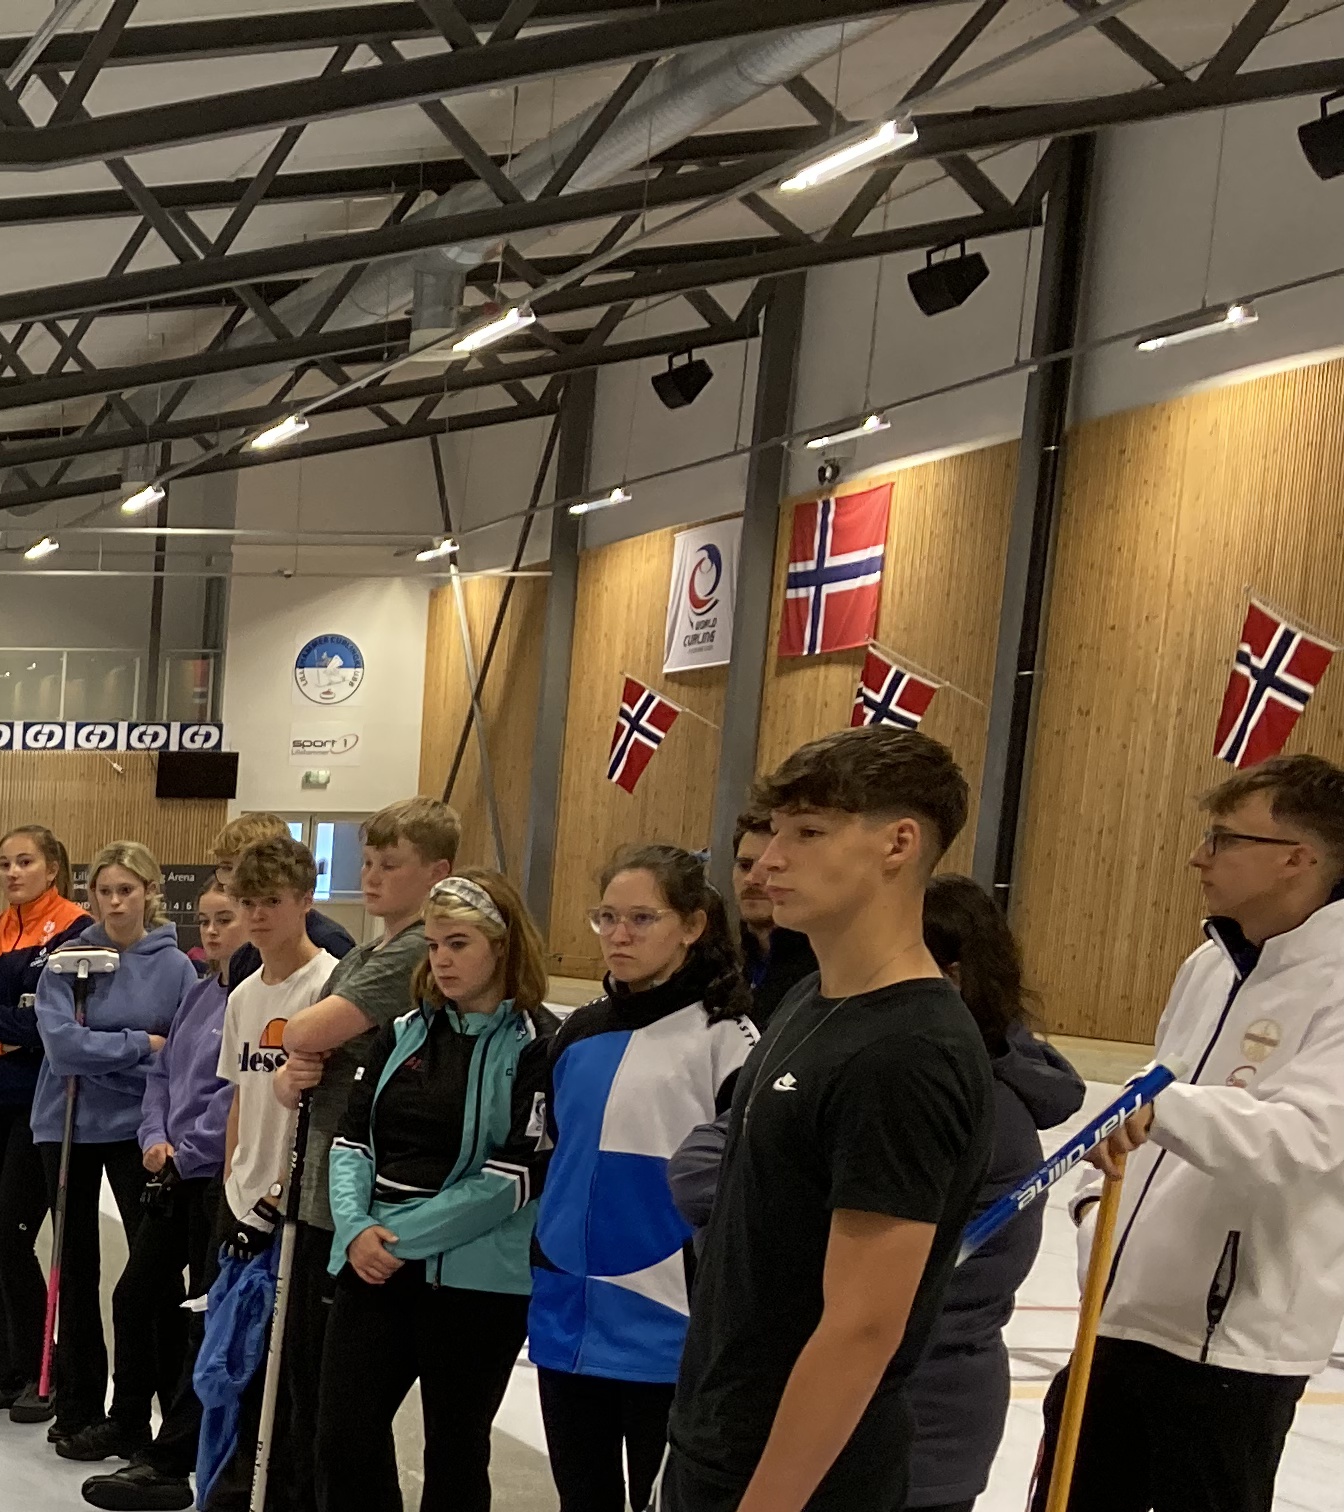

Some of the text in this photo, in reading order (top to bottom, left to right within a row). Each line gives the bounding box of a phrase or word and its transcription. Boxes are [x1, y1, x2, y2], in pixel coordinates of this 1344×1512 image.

[292, 738, 337, 750] sport
[167, 871, 195, 882] Arena
[1016, 1092, 1143, 1211] Hardline
